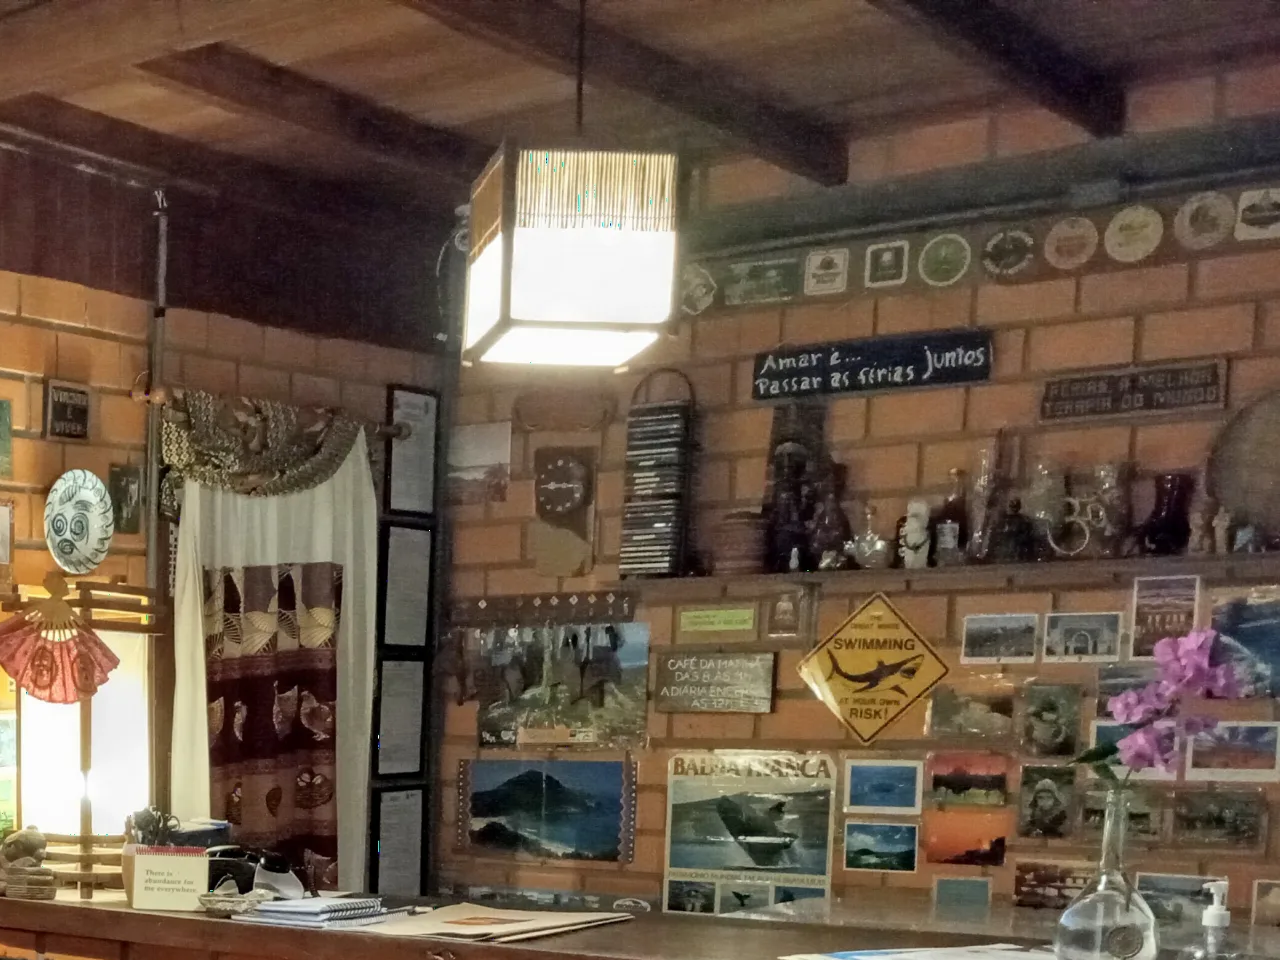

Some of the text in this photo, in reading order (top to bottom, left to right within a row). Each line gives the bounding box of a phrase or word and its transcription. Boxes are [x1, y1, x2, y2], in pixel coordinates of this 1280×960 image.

[760, 353, 822, 375] Amar
[755, 377, 822, 394] Passar
[830, 371, 849, 387] as
[833, 638, 916, 651] SWIMMING
[667, 656, 697, 671] CAFÉ
[700, 659, 715, 669] DA
[675, 671, 699, 682] DAS
[849, 707, 888, 720] RISK!
[144, 869, 165, 877] There
